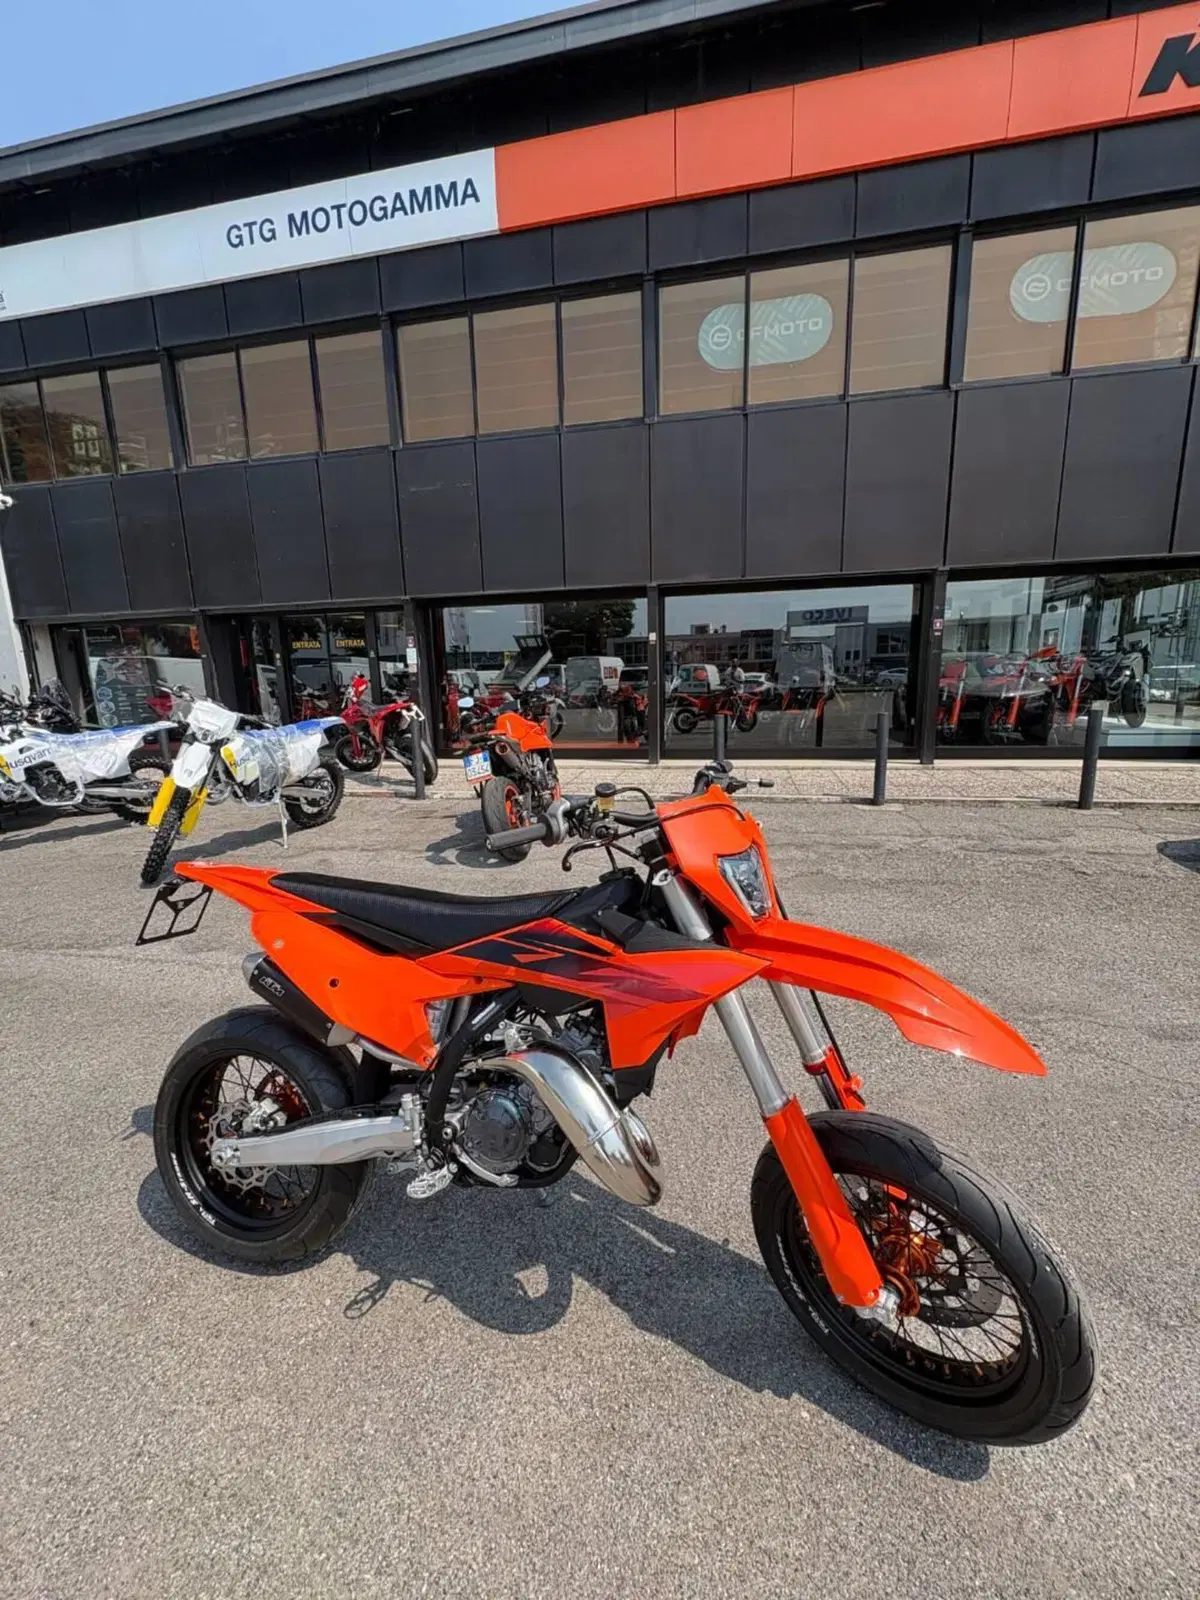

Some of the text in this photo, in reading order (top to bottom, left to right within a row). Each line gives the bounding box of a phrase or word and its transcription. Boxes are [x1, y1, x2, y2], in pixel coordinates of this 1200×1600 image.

[226, 177, 481, 249] GTG MOTOGAMMA
[292, 640, 321, 649] ENTRATA
[336, 639, 366, 649] ENTRATA
[259, 976, 285, 997] KTM
